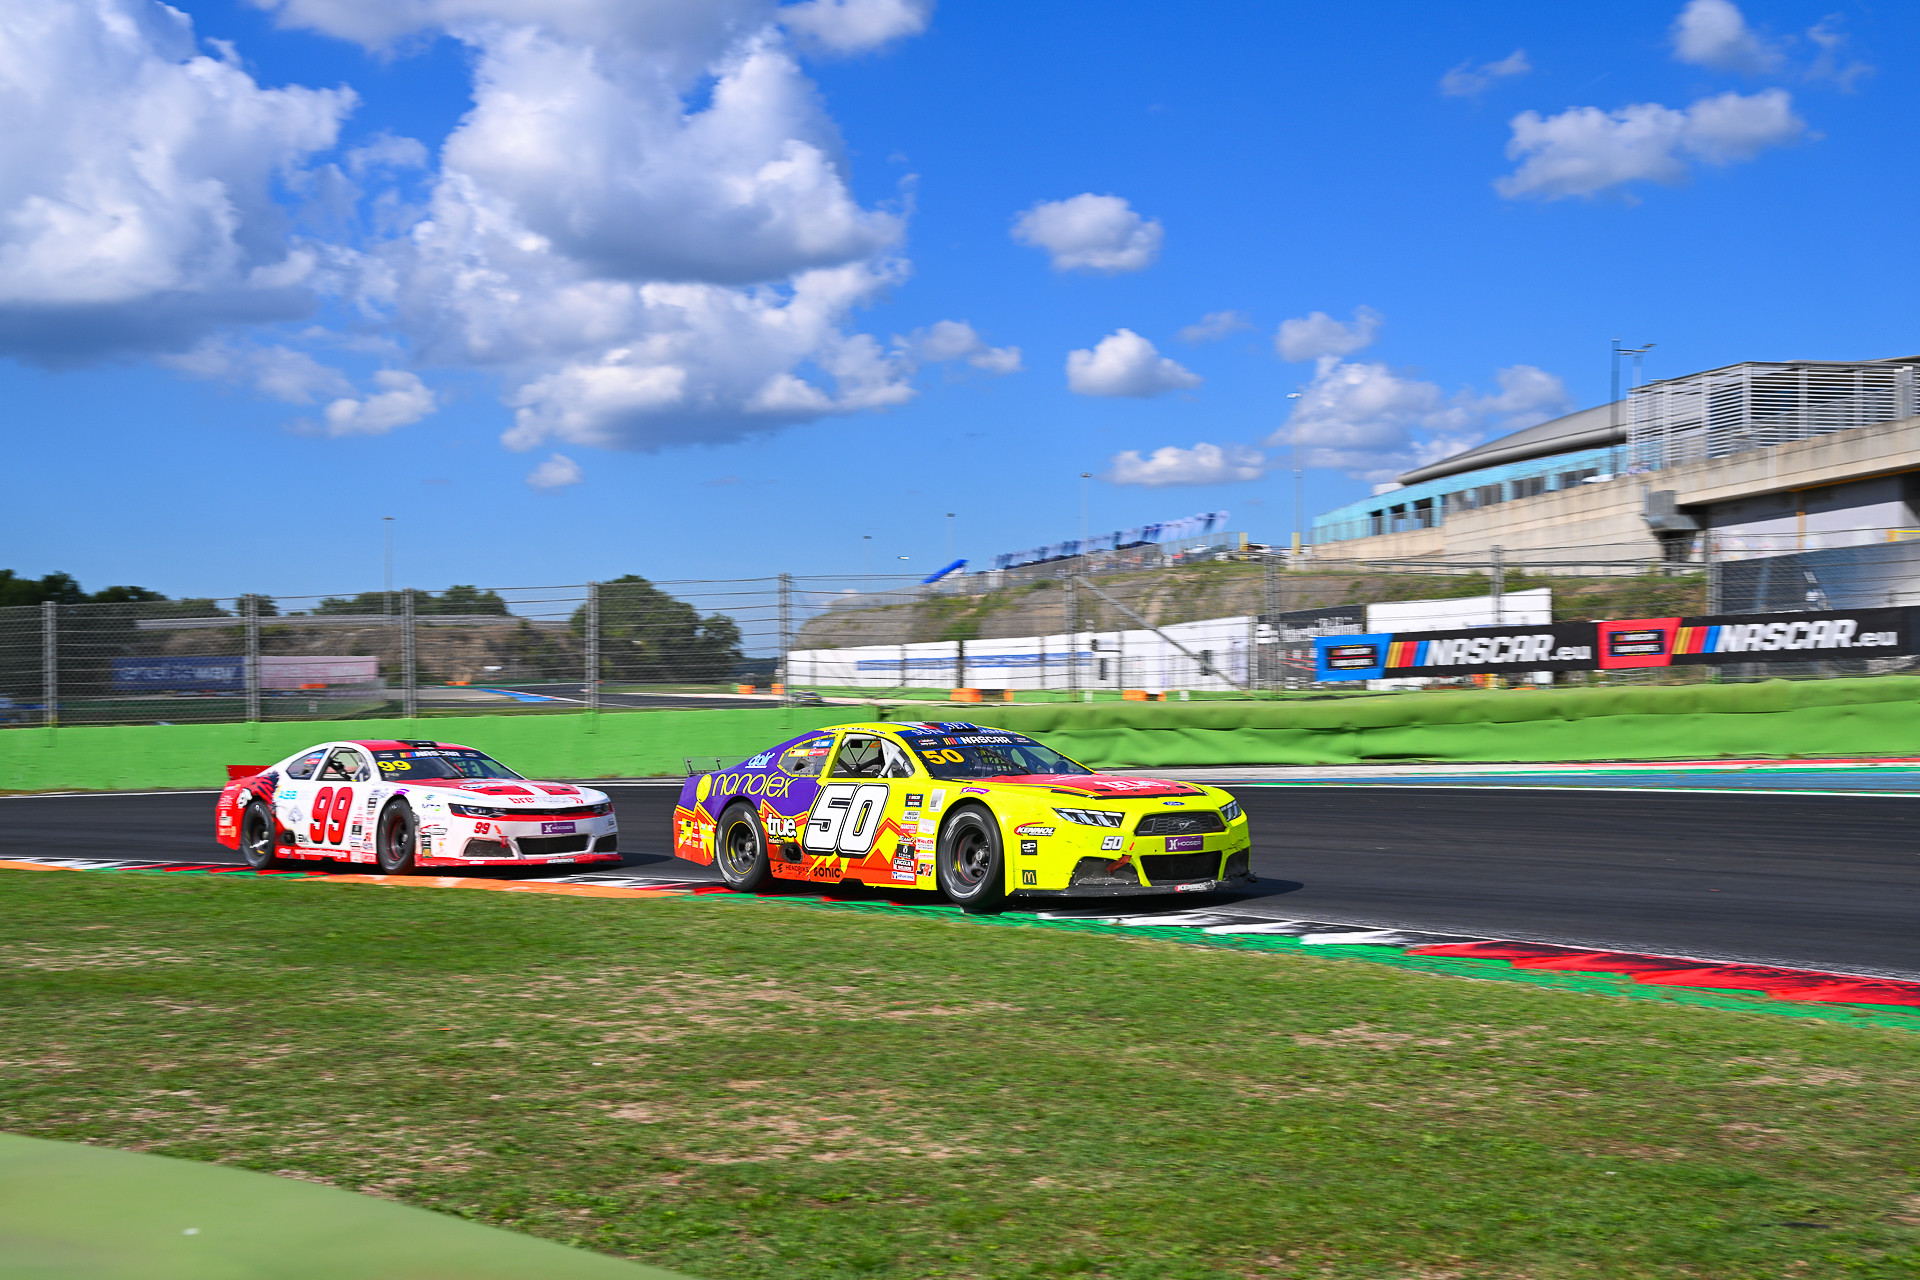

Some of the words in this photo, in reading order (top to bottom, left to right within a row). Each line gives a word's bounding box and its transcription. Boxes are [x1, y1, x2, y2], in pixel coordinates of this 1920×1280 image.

[1714, 619, 1898, 653] NASCAR.eu
[1423, 634, 1592, 666] NASCAR.eu
[960, 736, 1012, 744] NASCAR
[921, 749, 965, 765] 50
[377, 760, 412, 772] 99
[712, 772, 799, 798] nanolex
[310, 786, 353, 846] 99
[803, 783, 890, 858] 50
[474, 822, 491, 834] 99
[1016, 826, 1055, 834] KENNOL
[1101, 836, 1124, 850] 50
